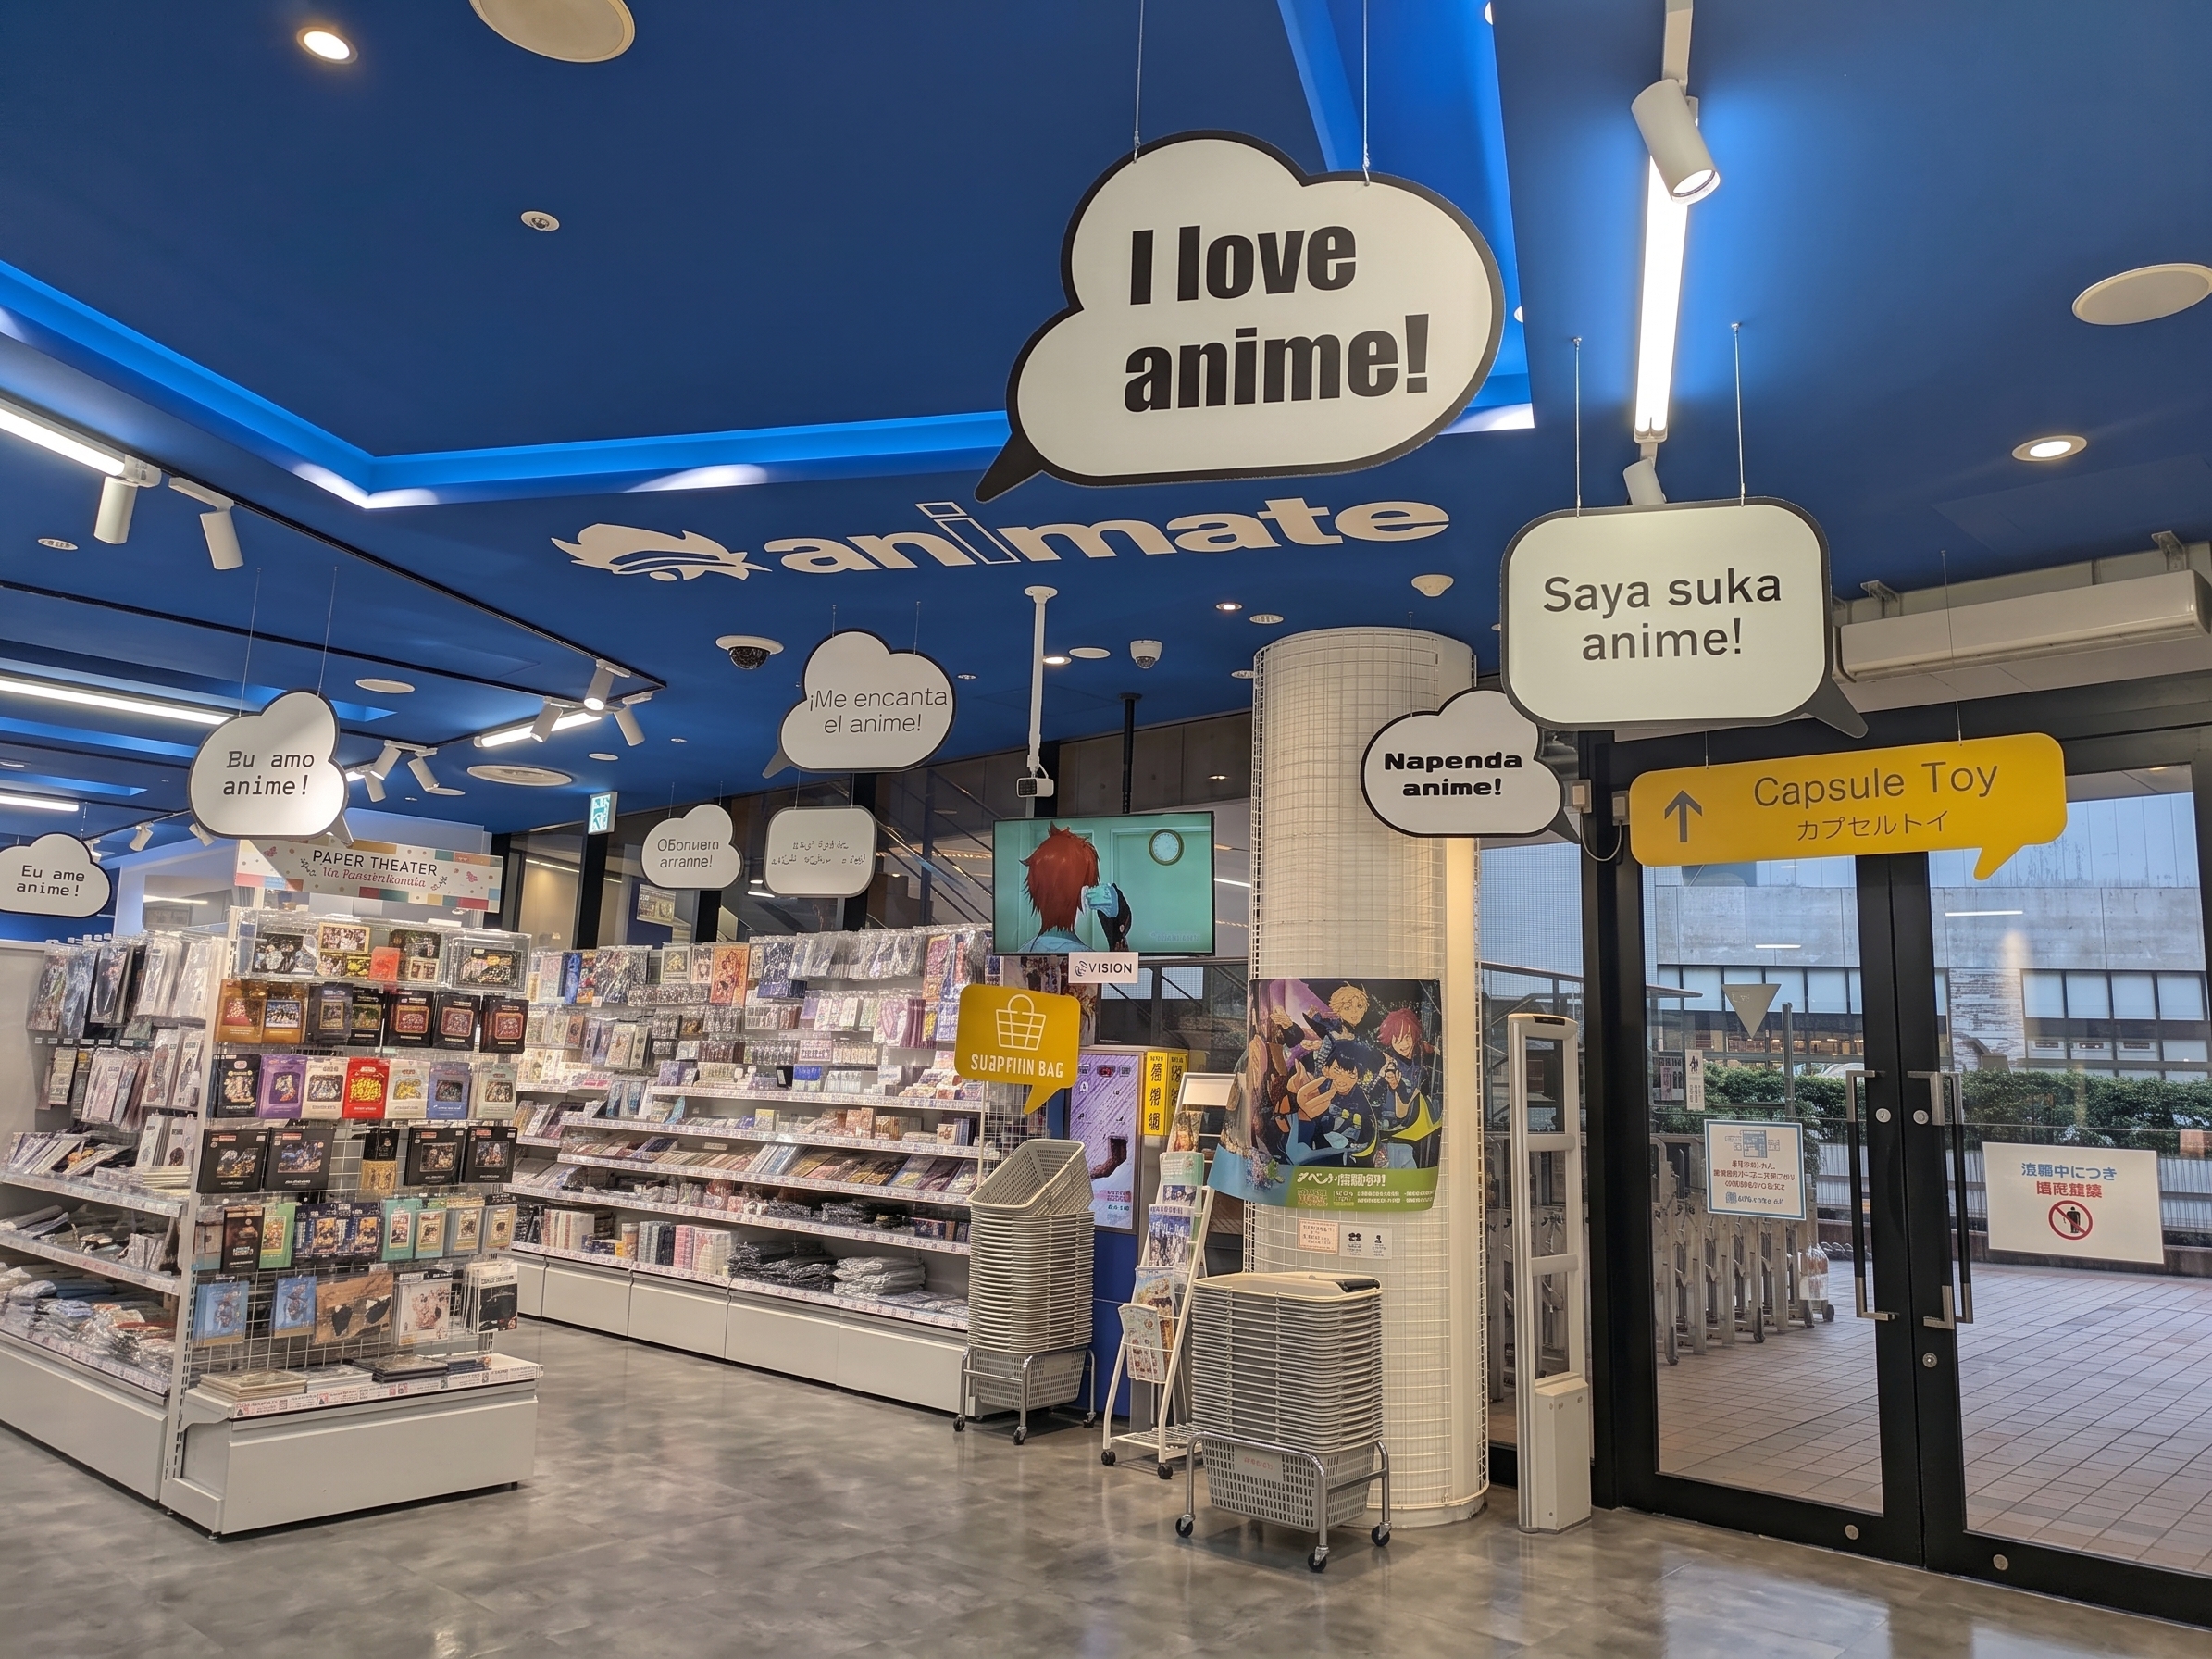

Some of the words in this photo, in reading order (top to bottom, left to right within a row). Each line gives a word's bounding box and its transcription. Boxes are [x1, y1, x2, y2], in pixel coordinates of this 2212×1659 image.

[1130, 229, 1154, 306] I
[1177, 225, 1357, 302] love
[1124, 313, 1430, 413] anime!
[764, 497, 1450, 574] animate
[1543, 575, 1651, 619] Saya
[1668, 568, 1782, 607] suka
[1582, 617, 1742, 661] anime!
[854, 688, 948, 707] encanta
[824, 715, 842, 733] el
[850, 714, 922, 733] anime!
[270, 754, 315, 768] amo
[1384, 752, 1523, 773] Napenda
[223, 774, 309, 795] anime!
[1402, 778, 1502, 796] anime!
[1754, 768, 1905, 808] Capsule
[1921, 761, 1998, 798] Toy
[1797, 810, 1948, 842] カプセルトイ
[21, 865, 43, 879] Eu
[53, 870, 85, 882] ame
[313, 849, 365, 868] PAPER
[370, 856, 438, 877] THEATER
[16, 882, 80, 897] anime!
[1088, 963, 1132, 974] VISION
[1038, 1060, 1063, 1079] BAG
